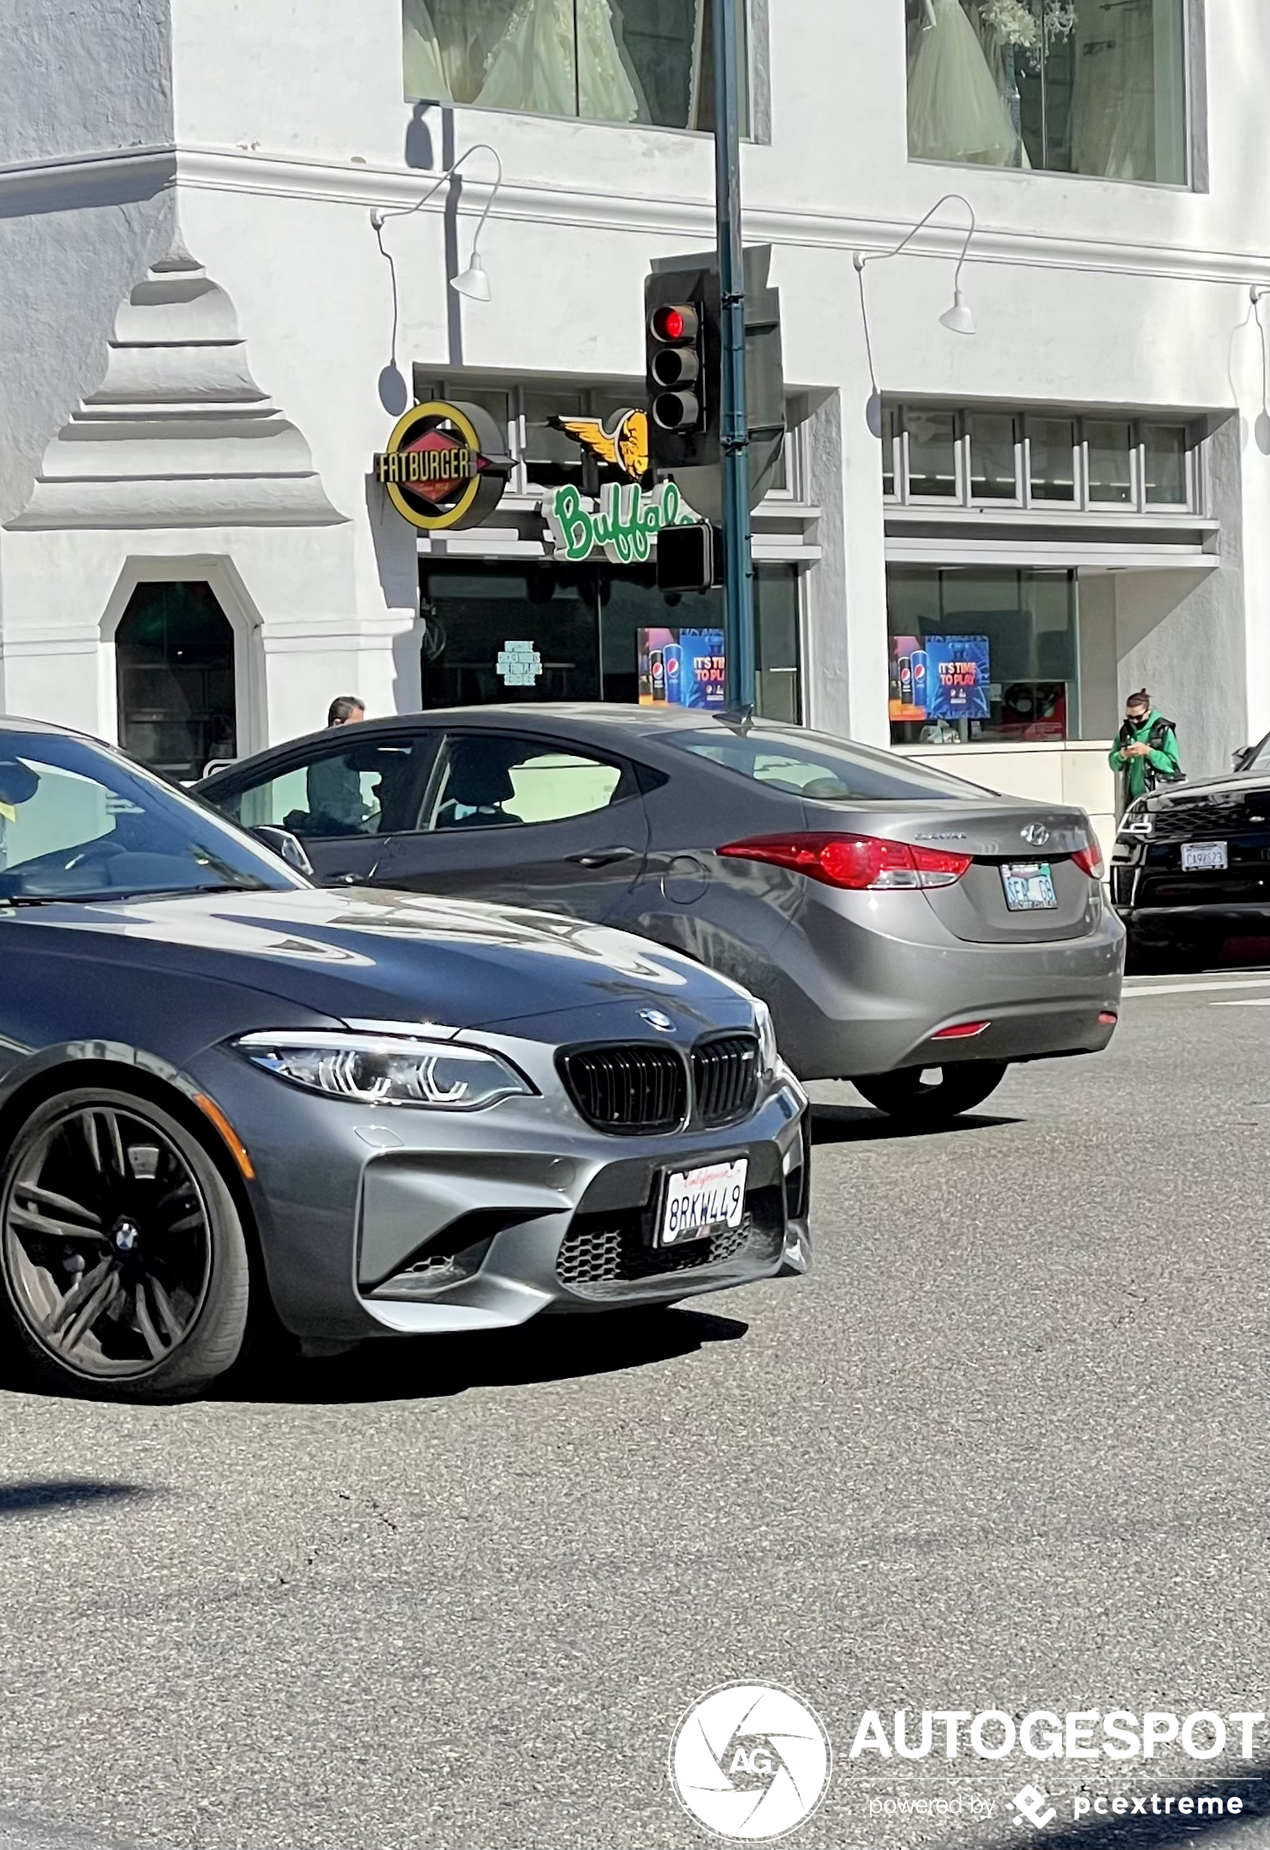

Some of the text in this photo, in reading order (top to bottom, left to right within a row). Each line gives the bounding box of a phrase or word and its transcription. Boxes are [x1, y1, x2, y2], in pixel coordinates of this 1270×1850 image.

[380, 448, 469, 482] FATBURGER
[553, 482, 696, 564] Buffal
[695, 669, 709, 681] TO
[955, 662, 977, 674] TIME
[940, 674, 975, 686] TO PLAY
[669, 1185, 741, 1231] 8RKW449
